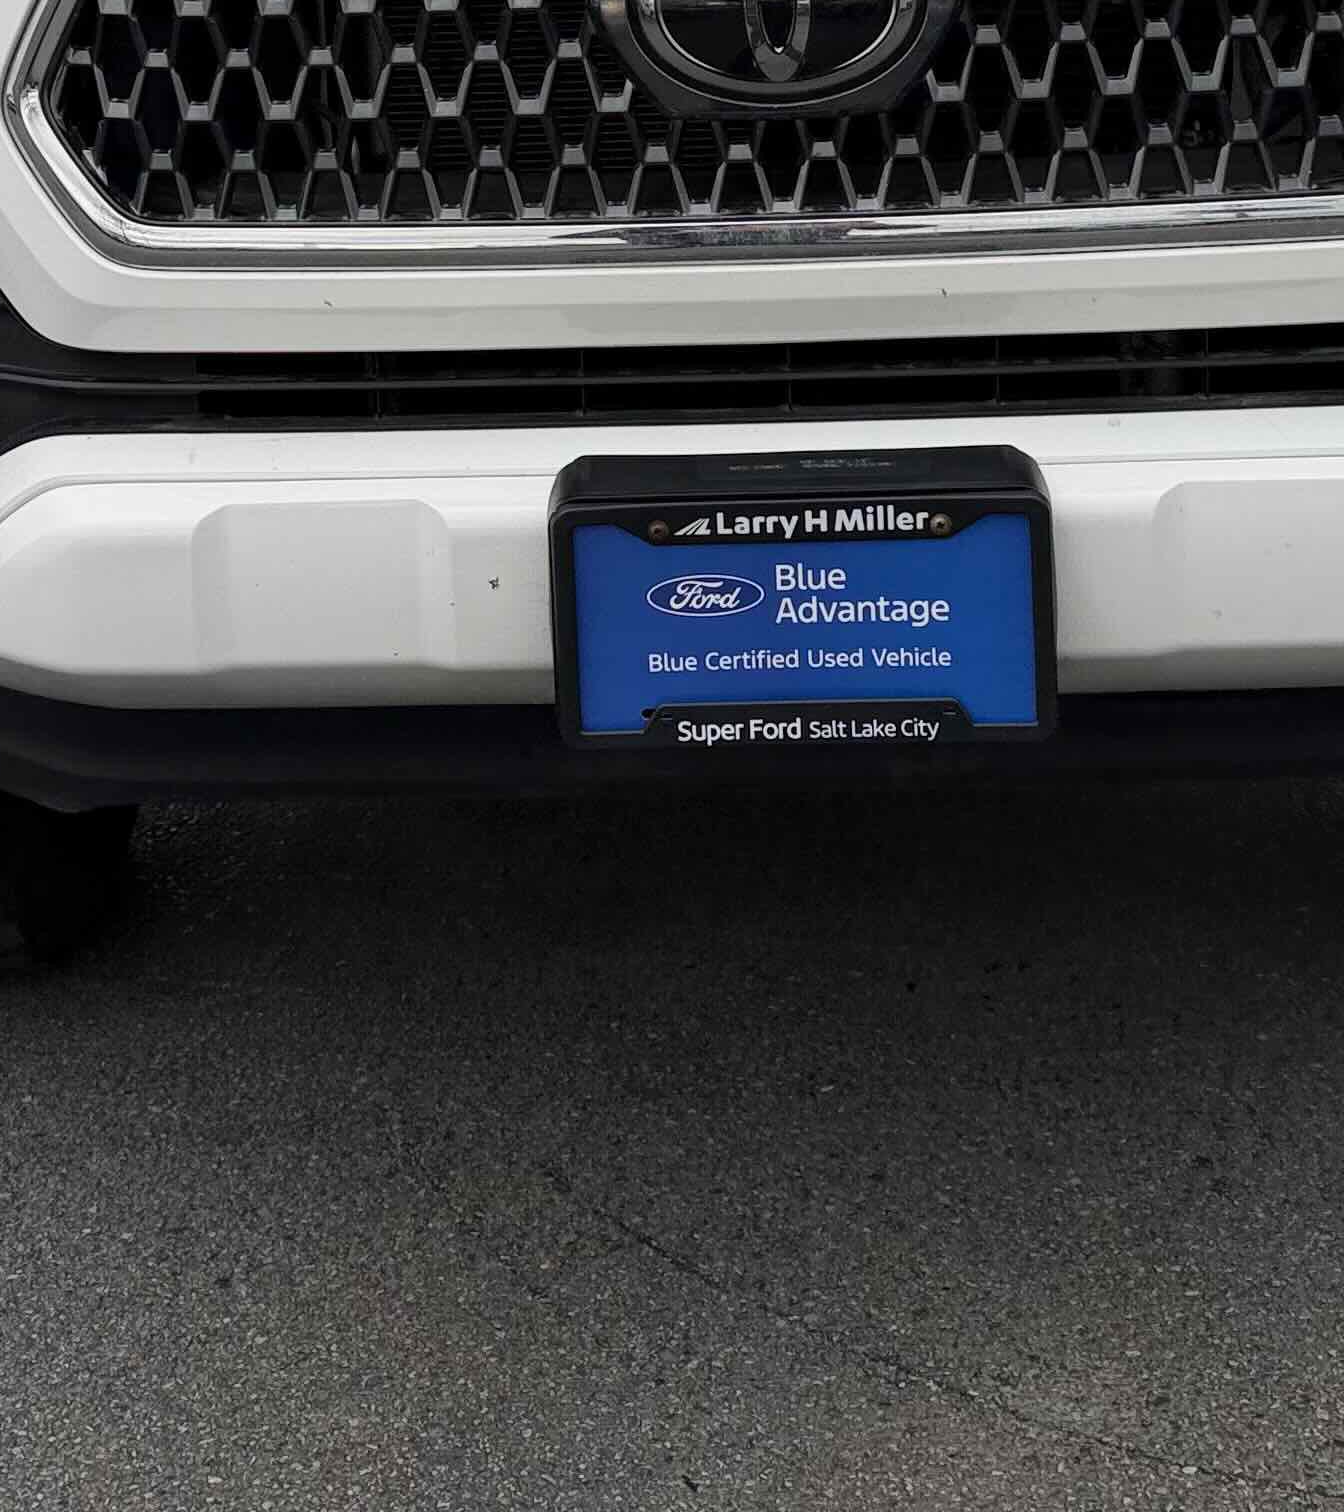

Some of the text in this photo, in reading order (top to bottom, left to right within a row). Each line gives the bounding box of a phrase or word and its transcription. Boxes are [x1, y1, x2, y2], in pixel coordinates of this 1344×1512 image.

[716, 505, 929, 539] Larry H Miller
[775, 562, 846, 591] Blue
[669, 579, 742, 610] Ford
[775, 595, 951, 627] Advantage
[647, 646, 952, 673] Blue Certified Used Vehicle
[677, 717, 940, 747] Super Ford Salt Lake City
